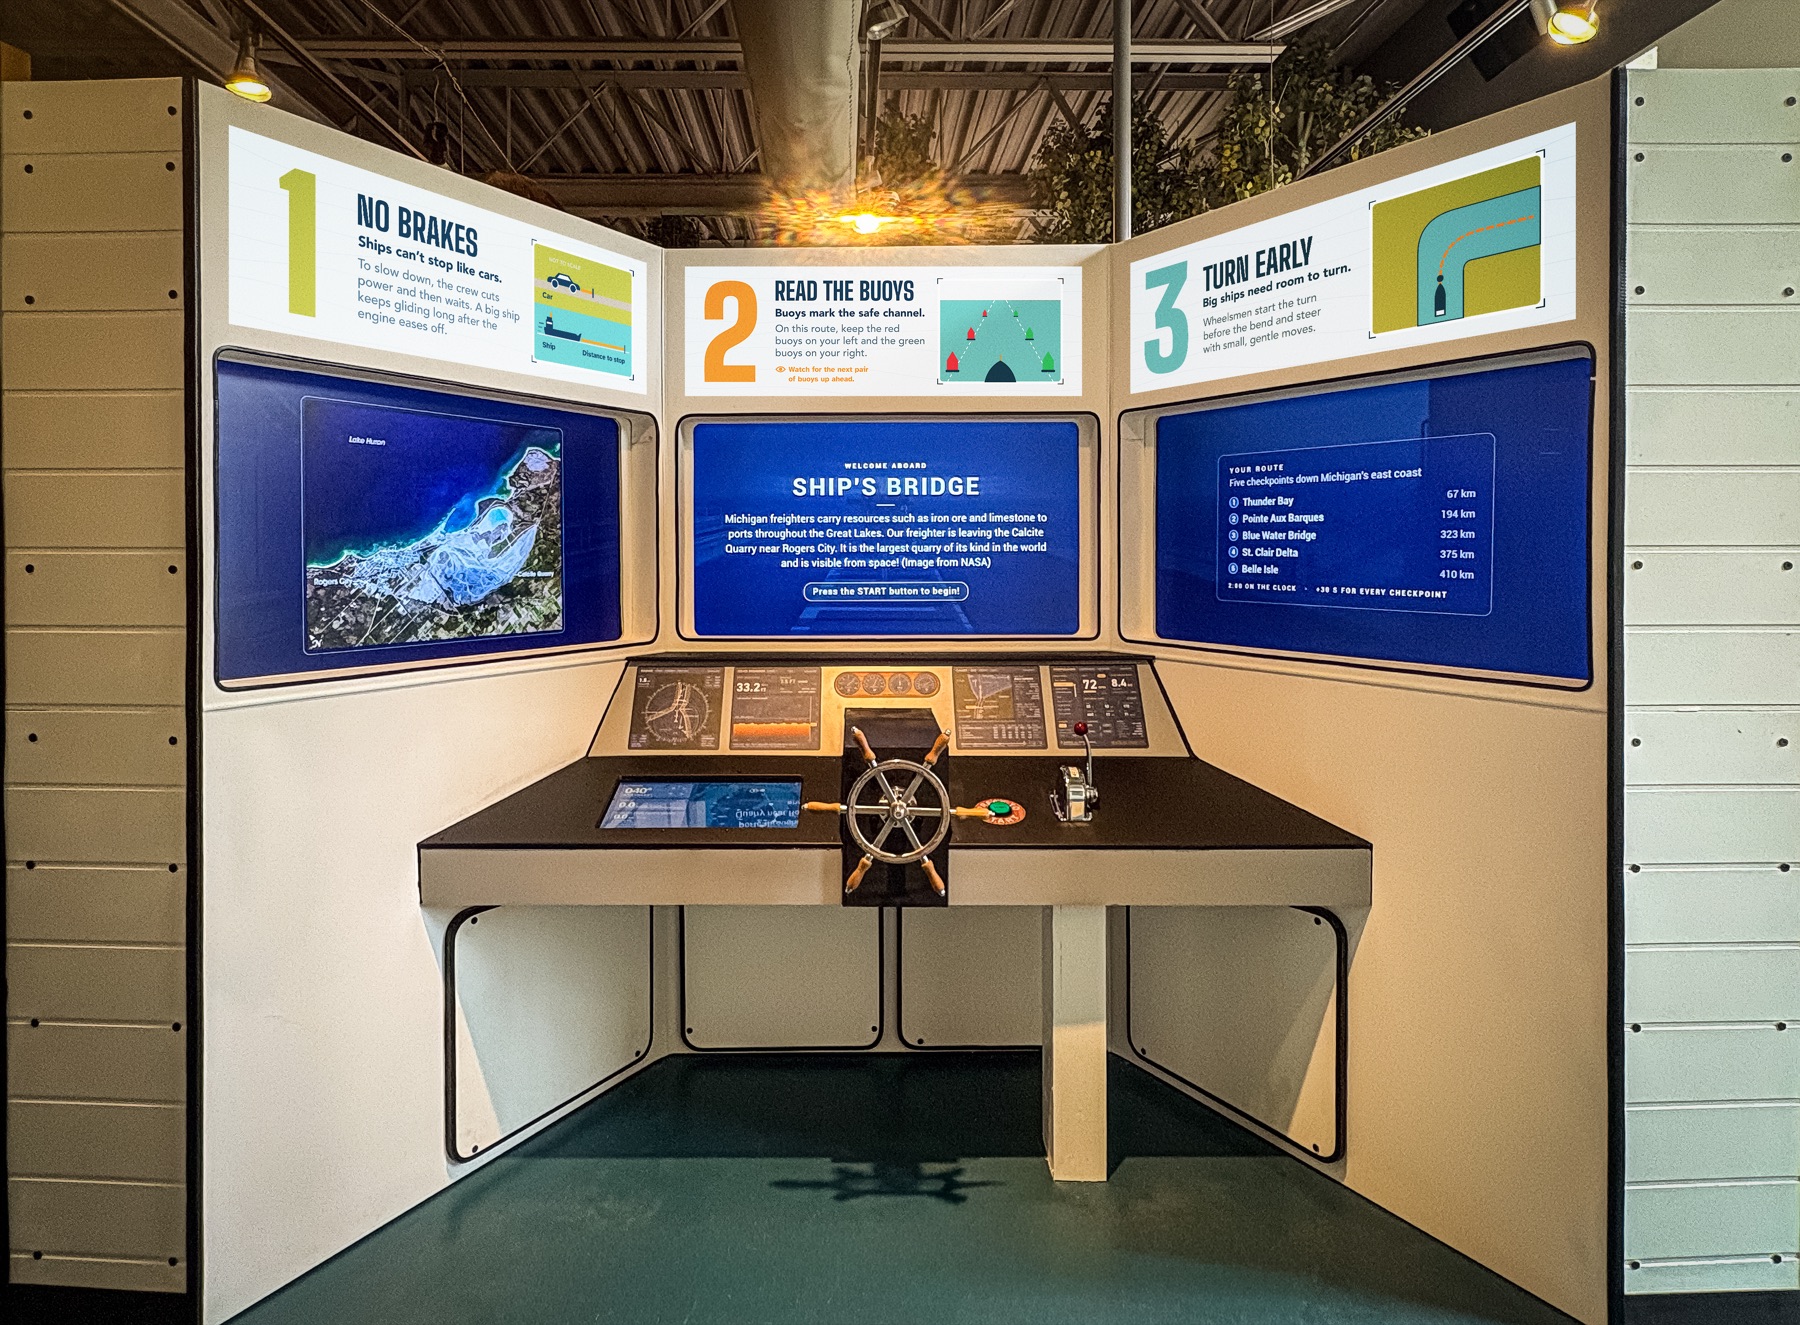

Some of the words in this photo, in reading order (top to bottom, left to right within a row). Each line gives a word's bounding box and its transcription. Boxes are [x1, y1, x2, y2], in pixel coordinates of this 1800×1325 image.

[358, 194, 389, 232] NO
[399, 206, 477, 257] BRAKES
[279, 168, 316, 318] 1
[358, 236, 392, 255] Ships
[396, 249, 424, 263] can't
[428, 257, 453, 272] stop
[457, 261, 475, 276] like
[479, 271, 502, 283] cars.
[1203, 254, 1248, 291] TURN
[1256, 236, 1312, 278] EARLY
[358, 258, 371, 270] To
[375, 263, 399, 277] slow
[403, 270, 434, 287] down,
[437, 278, 453, 290] the
[456, 286, 478, 296] crew
[481, 292, 499, 302] cuts
[776, 280, 817, 301] READ
[823, 280, 853, 301] THE
[860, 280, 914, 301] BUOYS
[1203, 297, 1217, 308] Big
[1221, 291, 1244, 303] ships
[1248, 281, 1272, 296] need
[1276, 276, 1304, 289] room
[1308, 272, 1320, 281] to
[1323, 265, 1351, 277] turn.
[542, 292, 553, 300] Car
[358, 291, 390, 309] keeps
[394, 300, 430, 318] gliding
[434, 307, 454, 324] long
[458, 314, 480, 326] after
[482, 317, 498, 330] the
[776, 309, 806, 319] Buoys
[810, 308, 835, 317] mark
[838, 308, 855, 317] the
[859, 308, 879, 317] safe
[883, 308, 924, 317] channel.
[1203, 310, 1252, 326] Wheelsmen
[1255, 304, 1275, 315] start
[1278, 299, 1294, 310] the
[1297, 295, 1316, 305] turn
[358, 311, 395, 324] engine
[399, 317, 429, 331] eases
[431, 323, 447, 334] off.
[704, 280, 757, 382] 2
[1148, 273, 1203, 415] 3
[1203, 342, 1220, 353] with
[1223, 336, 1247, 349] small,
[1250, 331, 1279, 346] gentle
[1282, 326, 1315, 338] moves.
[542, 342, 556, 350] Ship
[582, 350, 606, 360] Distance
[776, 348, 802, 359] buoys
[820, 351, 840, 359] your
[843, 348, 867, 359] right.
[1230, 466, 1251, 474] YOUR
[1256, 464, 1283, 472] ROUTE
[1230, 478, 1245, 487] Five
[1247, 475, 1294, 487] checkpoints
[1296, 474, 1318, 483] down
[1321, 471, 1369, 483] Michigan's
[1371, 470, 1392, 479] east
[1394, 468, 1422, 478] coast
[793, 478, 876, 496] SHIP'S
[888, 477, 979, 495] BRIDGE
[1447, 490, 1459, 498] 67
[1461, 489, 1476, 498] km
[1243, 496, 1276, 506] Thunder
[1278, 496, 1294, 507] Bay
[725, 514, 768, 525] Michigan
[770, 514, 815, 525] freighters
[817, 516, 841, 525] carry
[892, 513, 915, 522] such
[931, 513, 949, 522] iron
[969, 513, 986, 522] and
[989, 513, 1035, 522] limestone
[1038, 514, 1047, 522] to
[1243, 514, 1268, 523] Pointe
[1270, 514, 1286, 522] Aux
[1288, 513, 1324, 524] Barques
[1442, 510, 1458, 518] 194
[1461, 509, 1475, 518] km
[1243, 531, 1260, 540] Blue
[1262, 531, 1286, 540] Water
[1288, 530, 1316, 542] Bridge
[1440, 530, 1458, 538] 323
[1460, 530, 1475, 538] km
[1242, 548, 1253, 556] St.
[1255, 548, 1274, 556] Clair
[1276, 548, 1298, 557] Delta
[1440, 550, 1457, 558] 375
[1460, 550, 1474, 558] km
[781, 558, 798, 567] and
[801, 558, 809, 567] is
[812, 558, 842, 567] visible
[844, 558, 866, 567] from
[868, 558, 899, 569] space!
[901, 557, 934, 569] (Image
[936, 557, 958, 566] from
[961, 557, 991, 568] NASA)
[1242, 564, 1262, 573] Belle
[1264, 565, 1278, 574] Isle
[1440, 570, 1457, 578] 410
[1460, 570, 1474, 579] km
[840, 587, 855, 595] the
[858, 587, 886, 595] START
[889, 587, 918, 595] button
[933, 586, 959, 596] begin!
[1390, 589, 1447, 598] CHECKPOINT
[736, 682, 761, 692] 33.2
[1082, 680, 1097, 689] 72
[1111, 679, 1127, 687] 8.4
